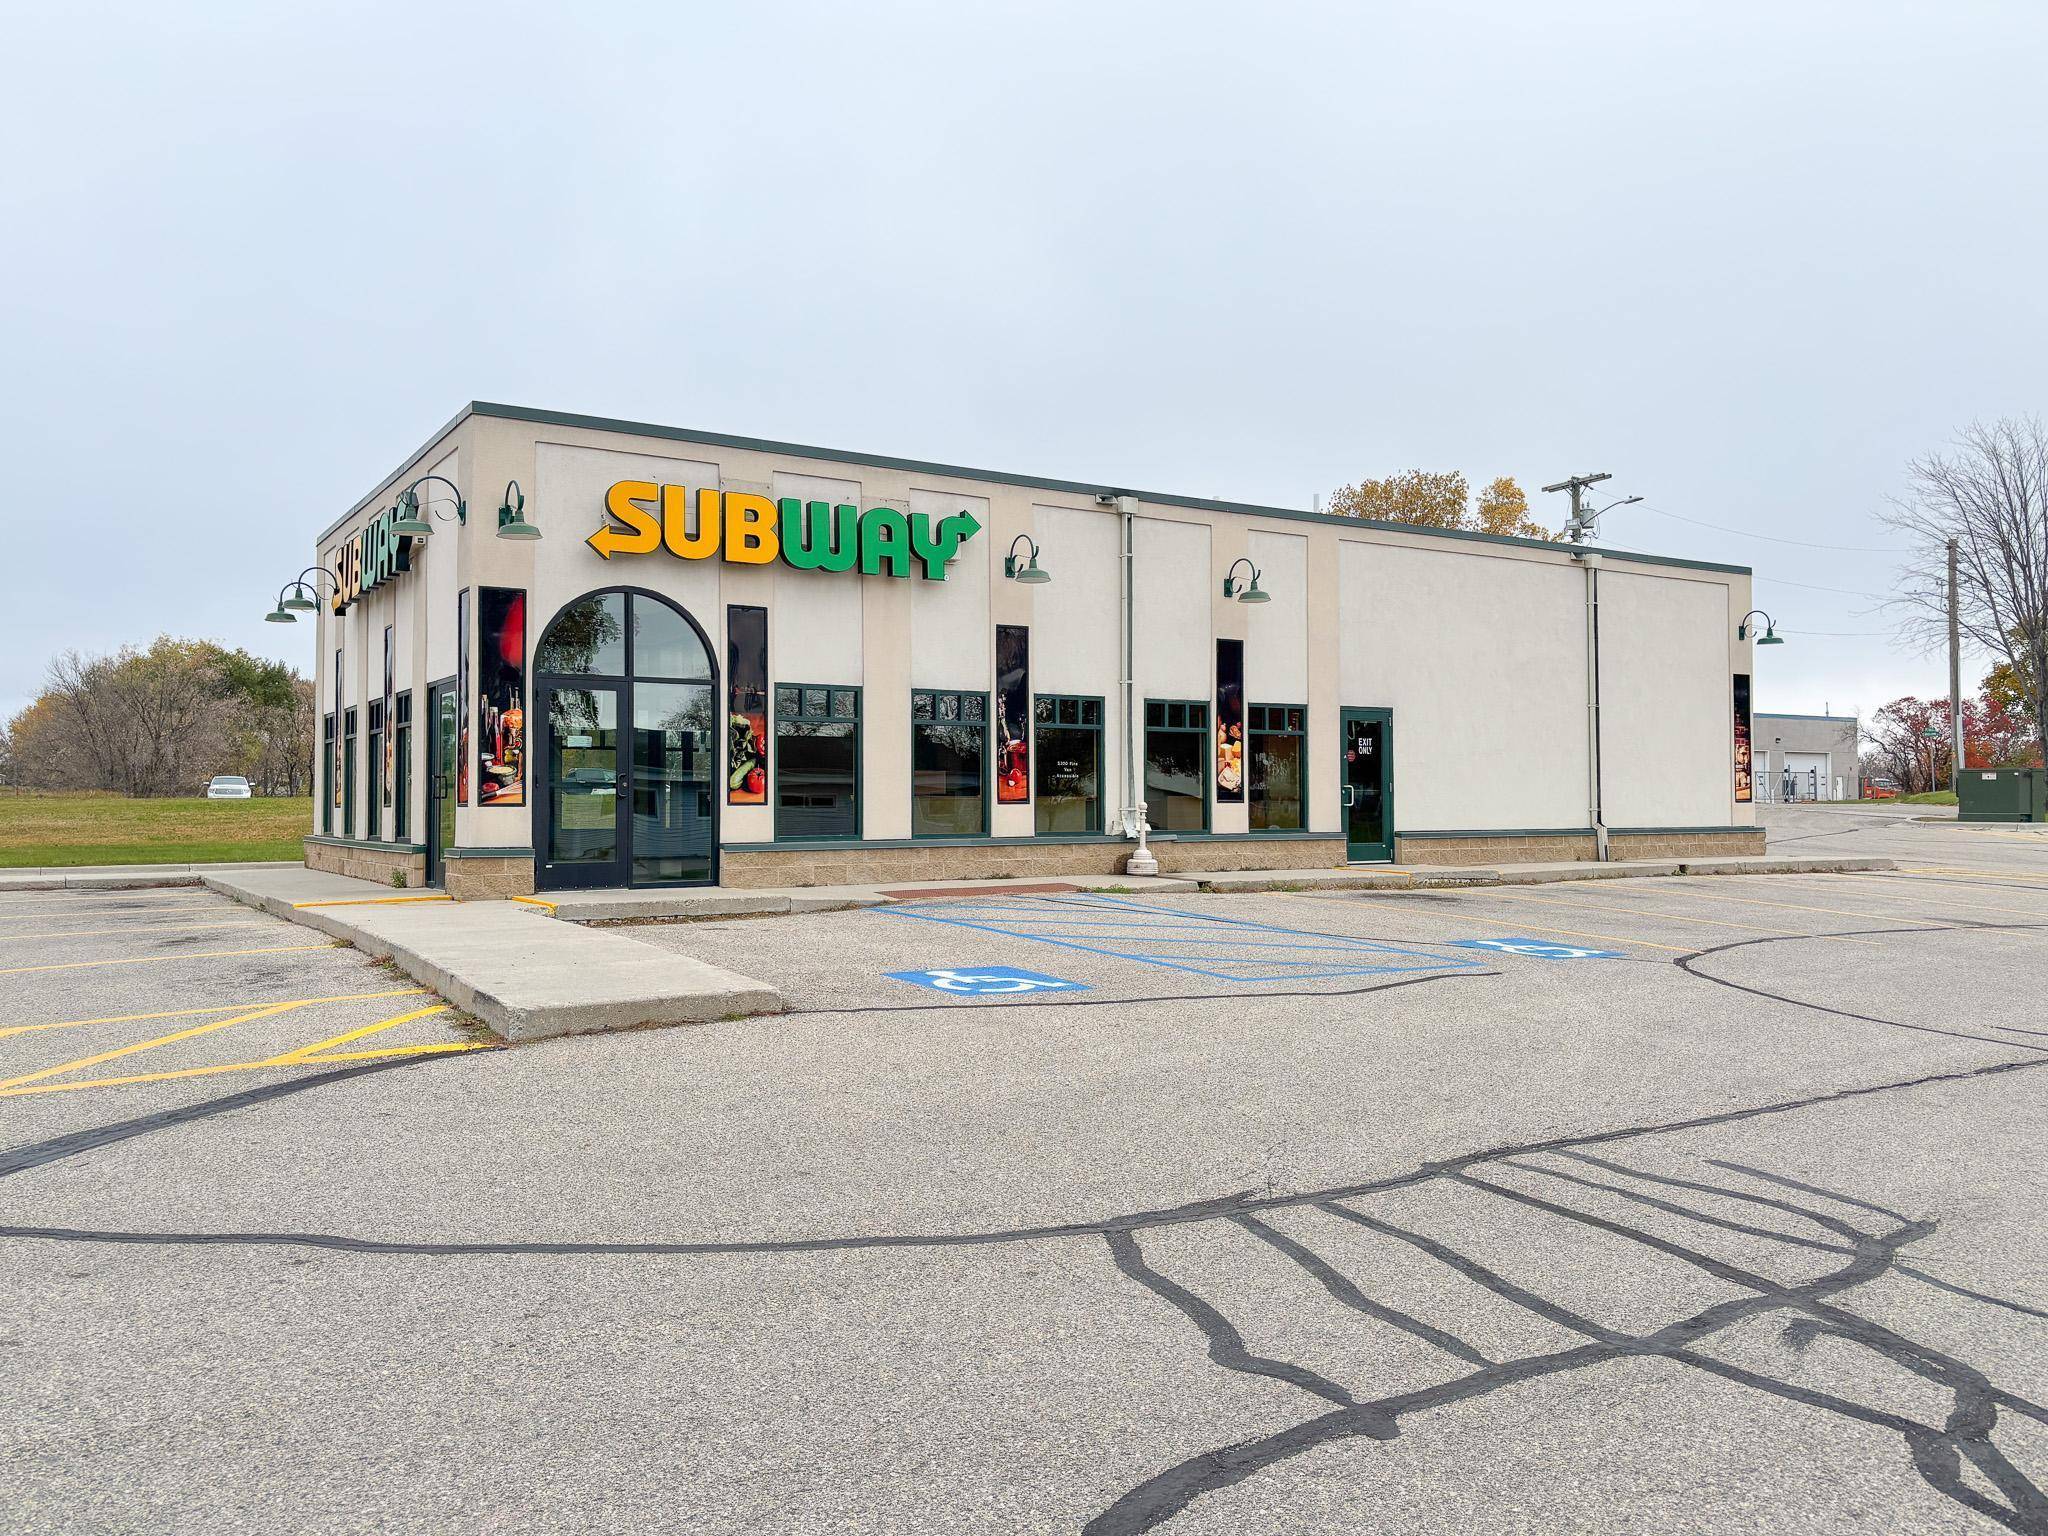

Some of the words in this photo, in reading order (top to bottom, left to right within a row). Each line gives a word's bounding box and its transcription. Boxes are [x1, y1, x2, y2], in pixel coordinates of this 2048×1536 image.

[332, 492, 413, 615] SUBWAY
[585, 479, 982, 581] SUBWAY
[1358, 737, 1373, 746] EXIT
[1358, 746, 1373, 755] ONLY
